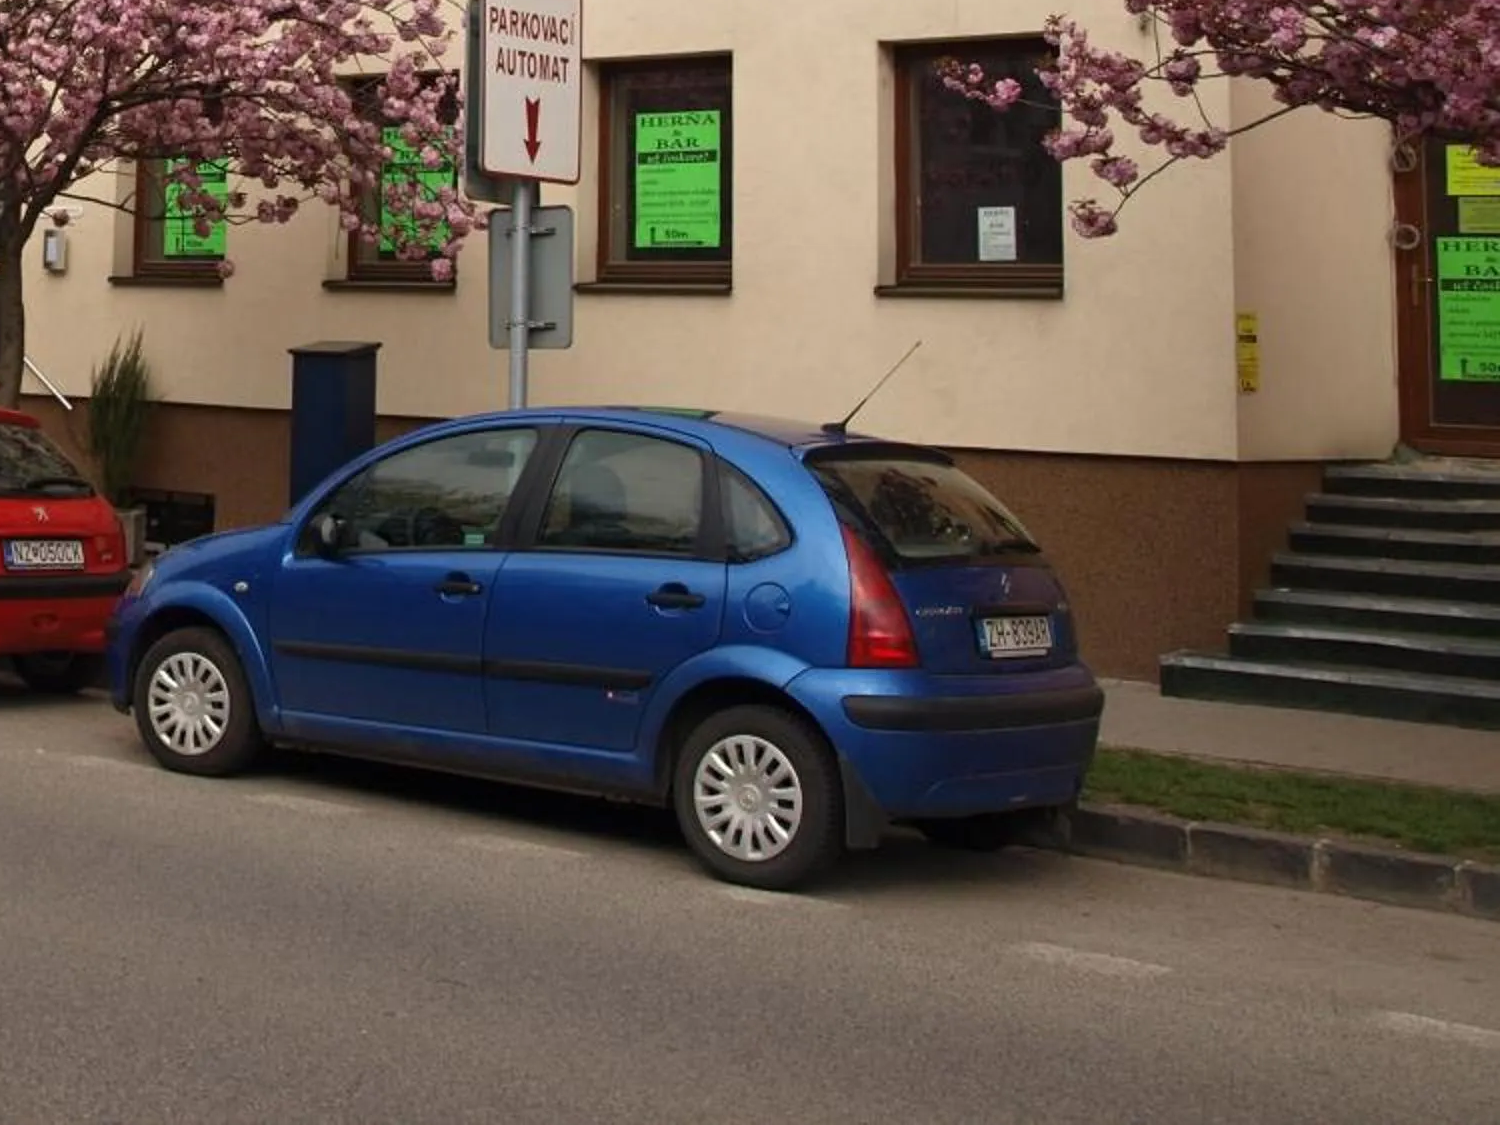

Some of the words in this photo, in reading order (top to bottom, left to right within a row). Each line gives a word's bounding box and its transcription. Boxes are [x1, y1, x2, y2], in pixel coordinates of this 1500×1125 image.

[489, 6, 575, 46] PARKOVACÍ
[495, 47, 570, 84] AUTOMAT
[656, 138, 700, 150] BAR
